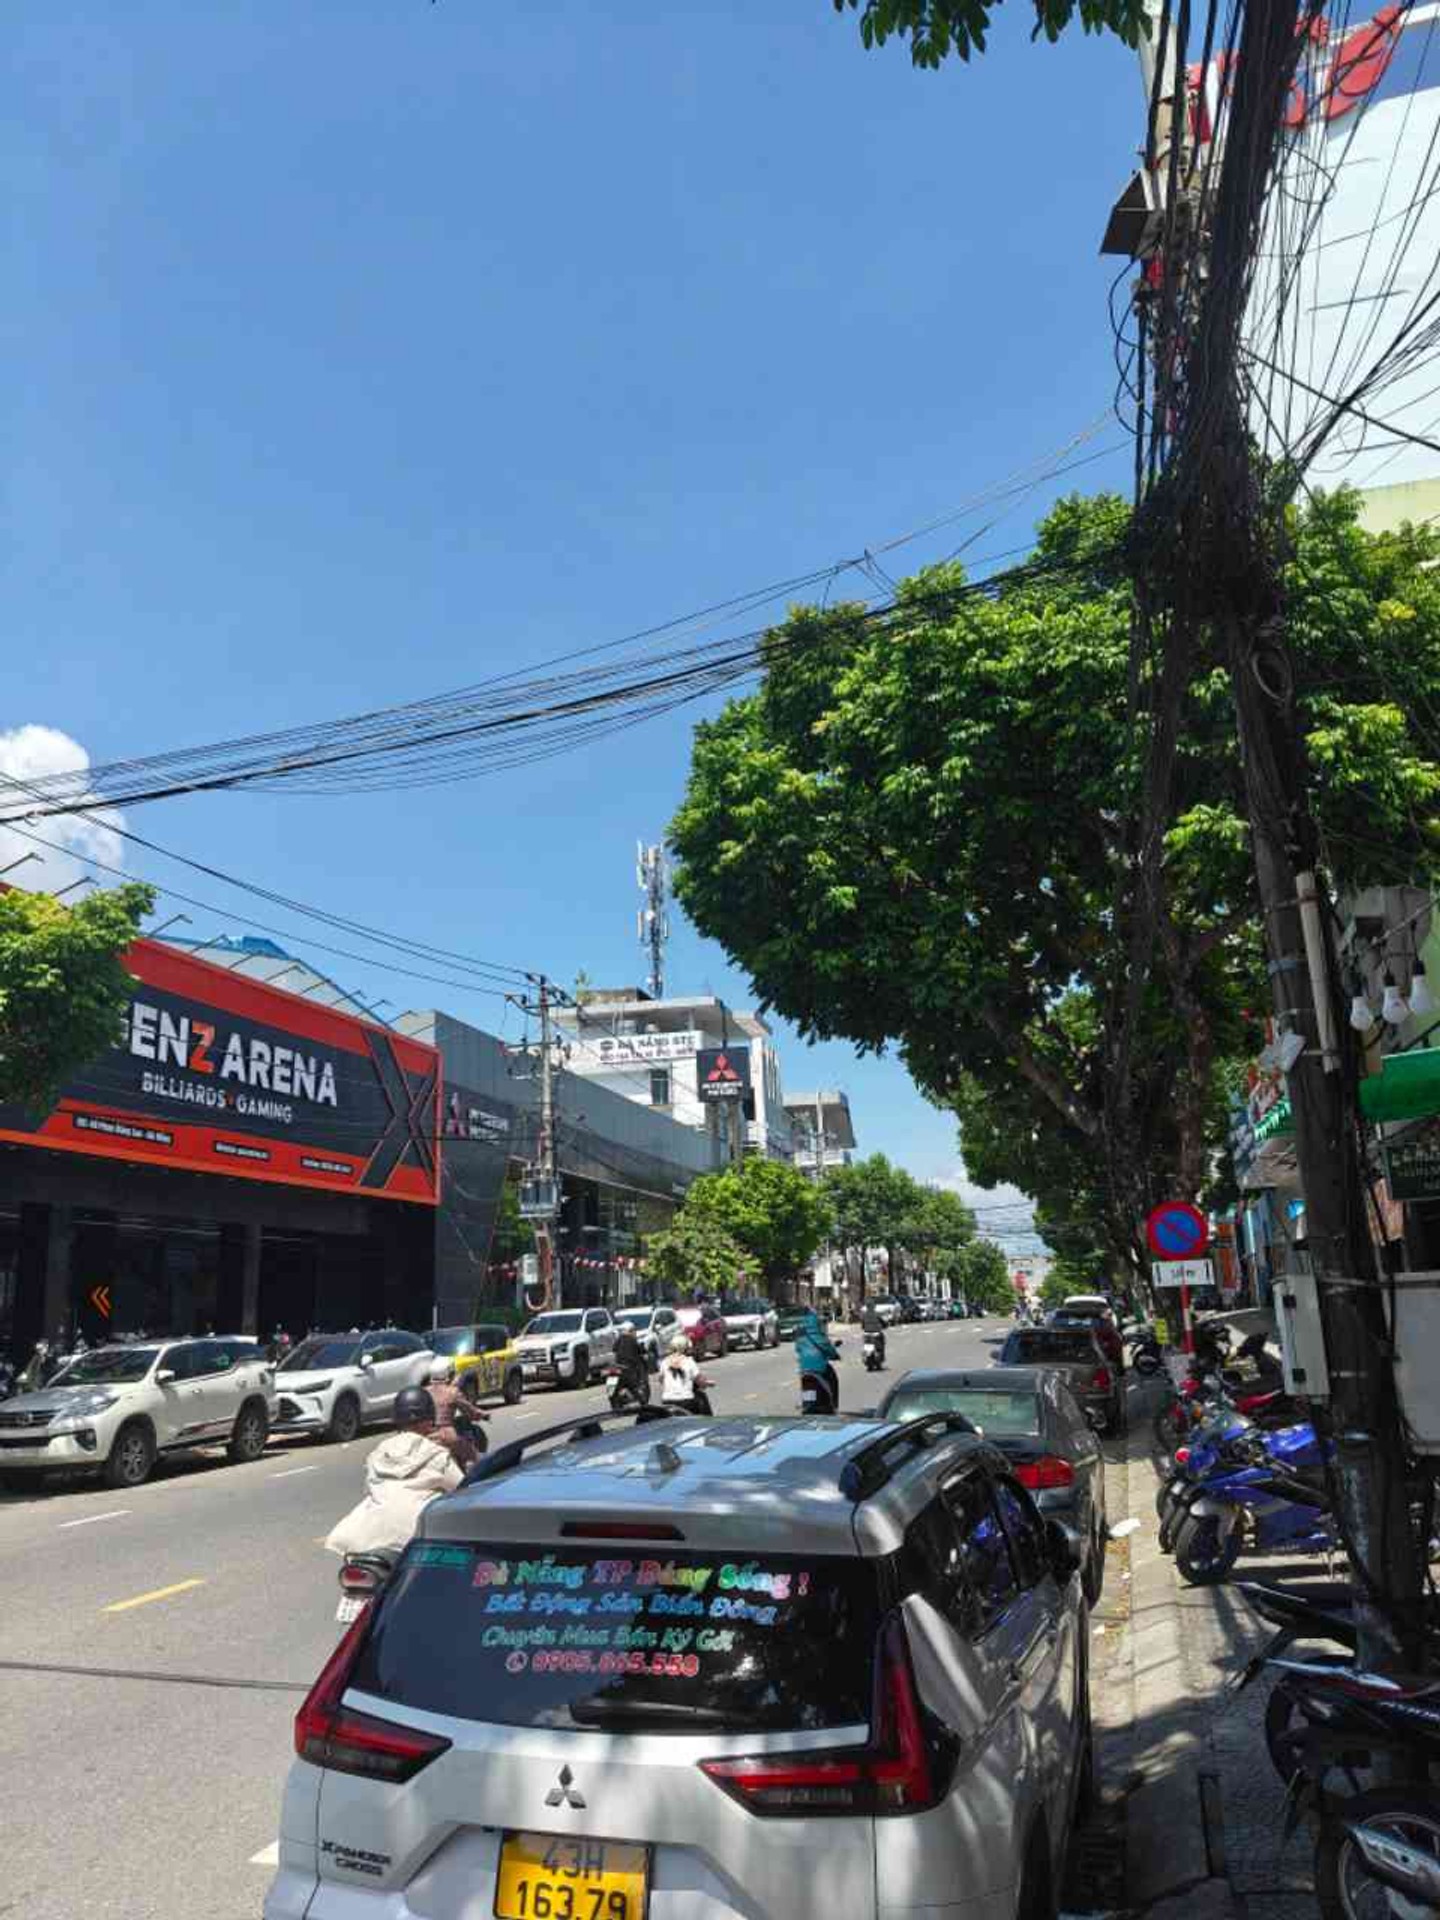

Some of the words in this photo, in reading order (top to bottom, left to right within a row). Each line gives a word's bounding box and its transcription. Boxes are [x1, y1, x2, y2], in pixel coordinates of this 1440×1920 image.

[122, 1001, 216, 1074] ENZ
[220, 1033, 338, 1106] ARENA
[141, 1071, 226, 1109] BILLIARDS
[236, 1094, 293, 1124] GAMING
[335, 1857, 384, 1877] CROSS
[541, 1838, 606, 1881] 43H
[516, 1880, 629, 1920] 163.79
